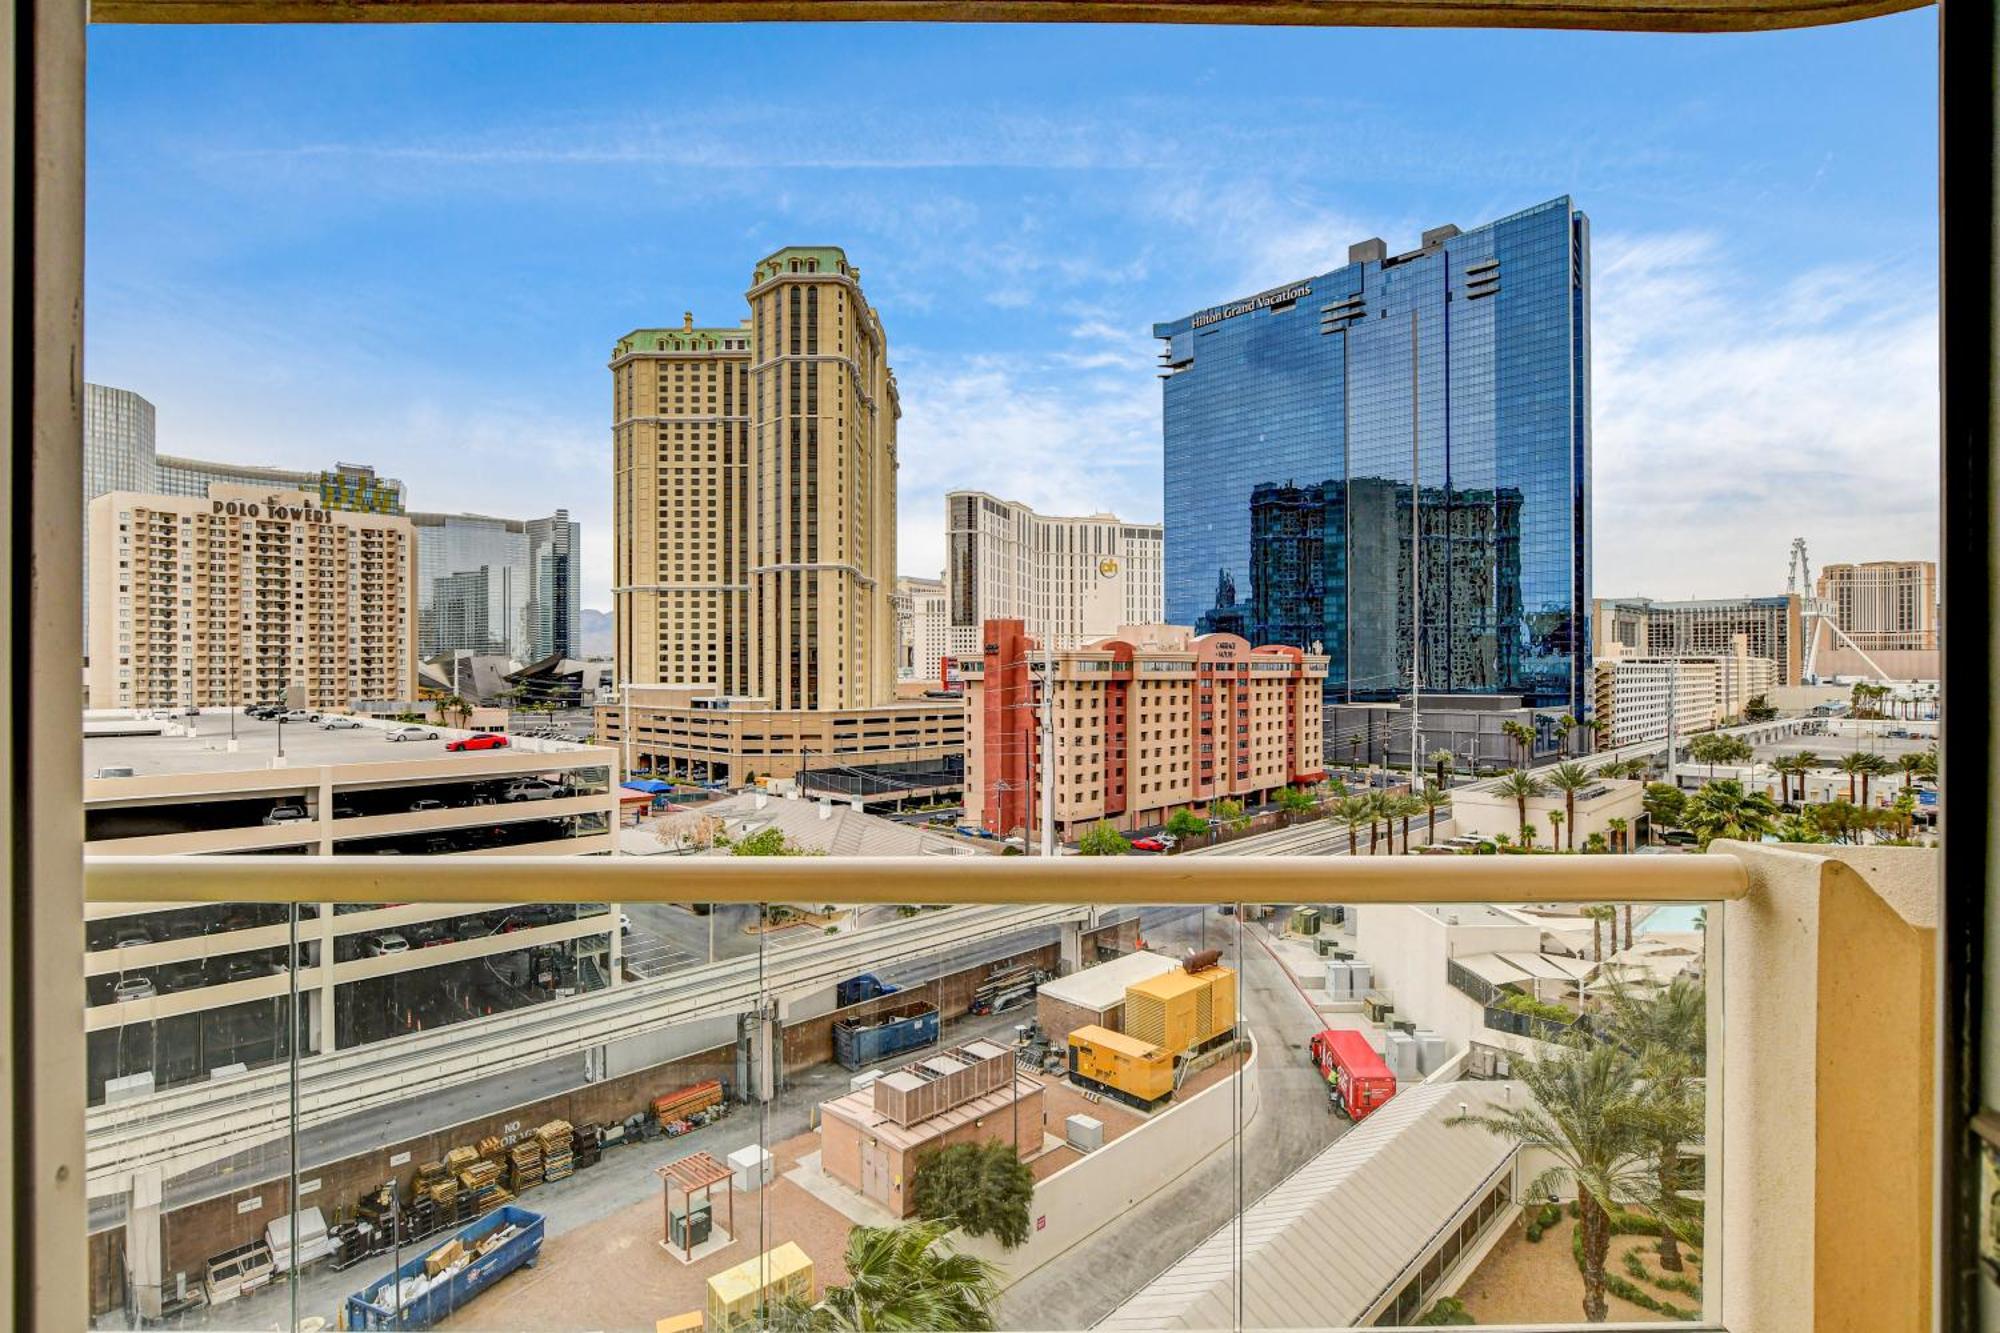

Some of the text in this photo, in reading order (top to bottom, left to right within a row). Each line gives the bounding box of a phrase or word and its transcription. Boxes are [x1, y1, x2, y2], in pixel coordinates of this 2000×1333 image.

[1192, 285, 1312, 329] Hilton Grand Vacations
[213, 500, 332, 523] POLO TOWERS
[504, 1120, 521, 1134] NO
